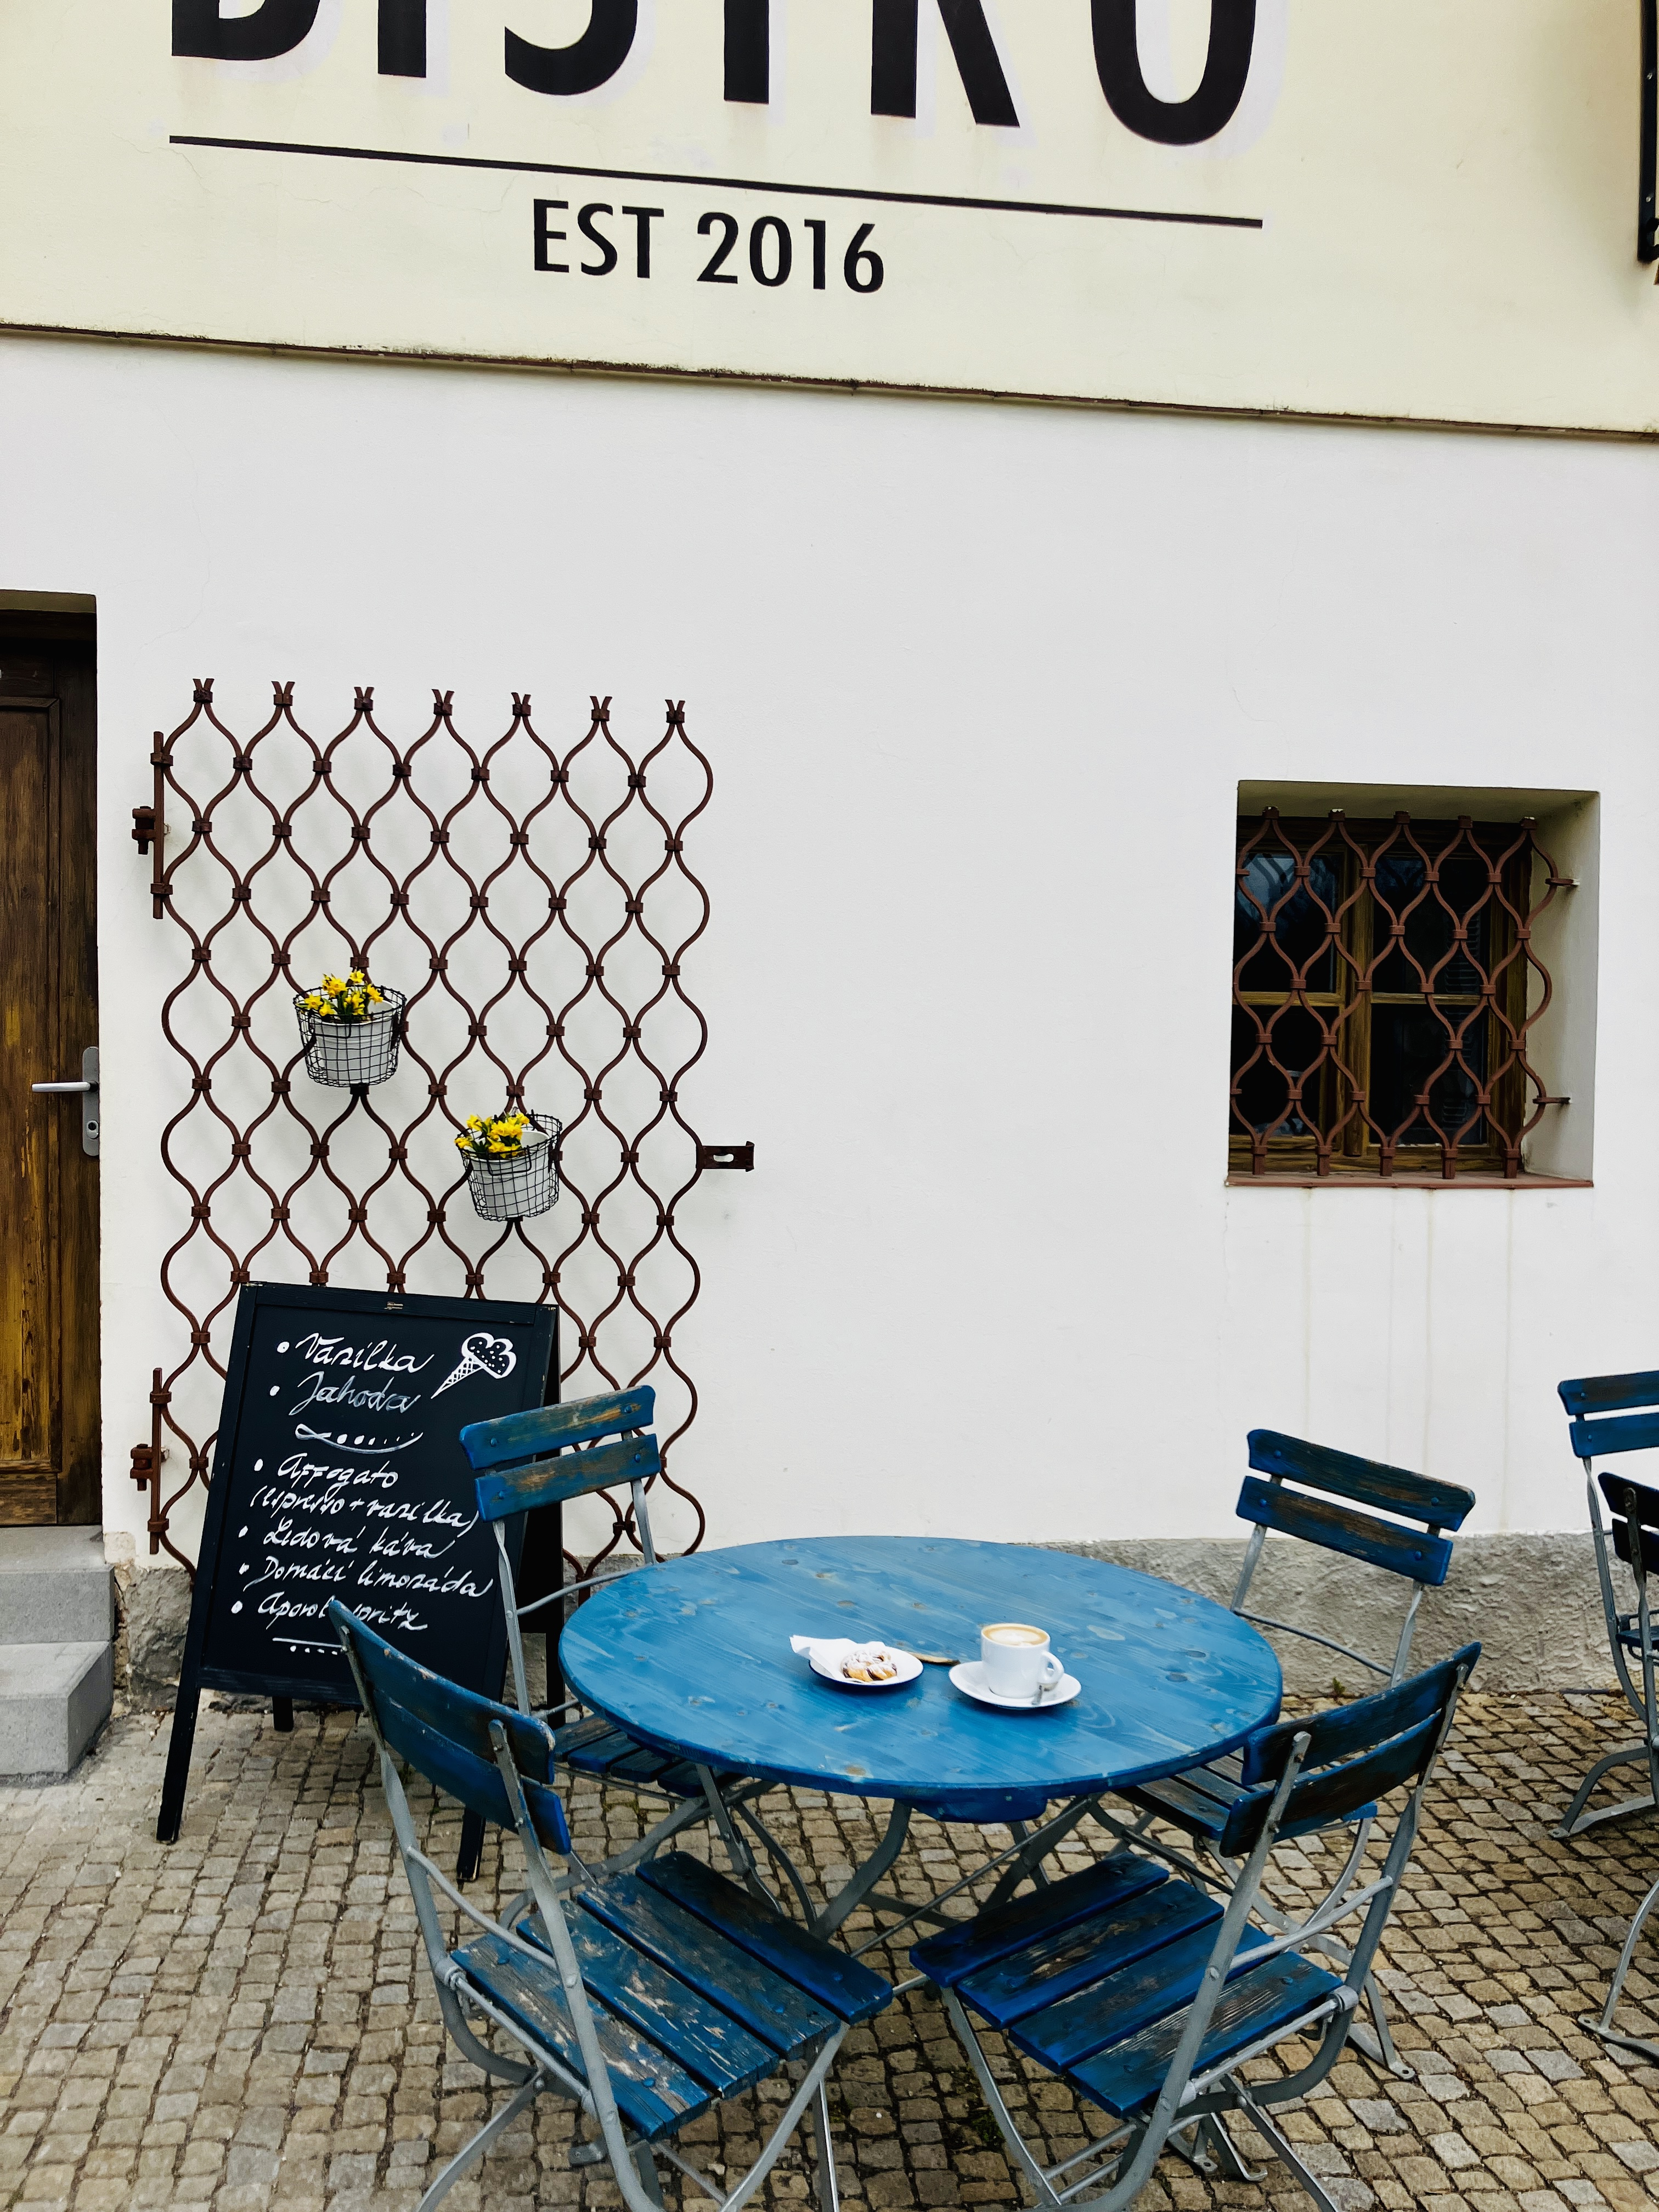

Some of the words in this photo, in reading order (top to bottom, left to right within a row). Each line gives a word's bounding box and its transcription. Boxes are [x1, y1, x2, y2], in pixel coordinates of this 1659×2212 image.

[533, 198, 664, 279] EST
[696, 211, 884, 294] 2016
[295, 1332, 435, 1374] Vanilka
[288, 1371, 422, 1415] Jahoda
[277, 1452, 399, 1504] Affogato
[263, 1516, 366, 1554] Ledová
[369, 1526, 455, 1559] káva
[357, 1559, 494, 1598] limonáda
